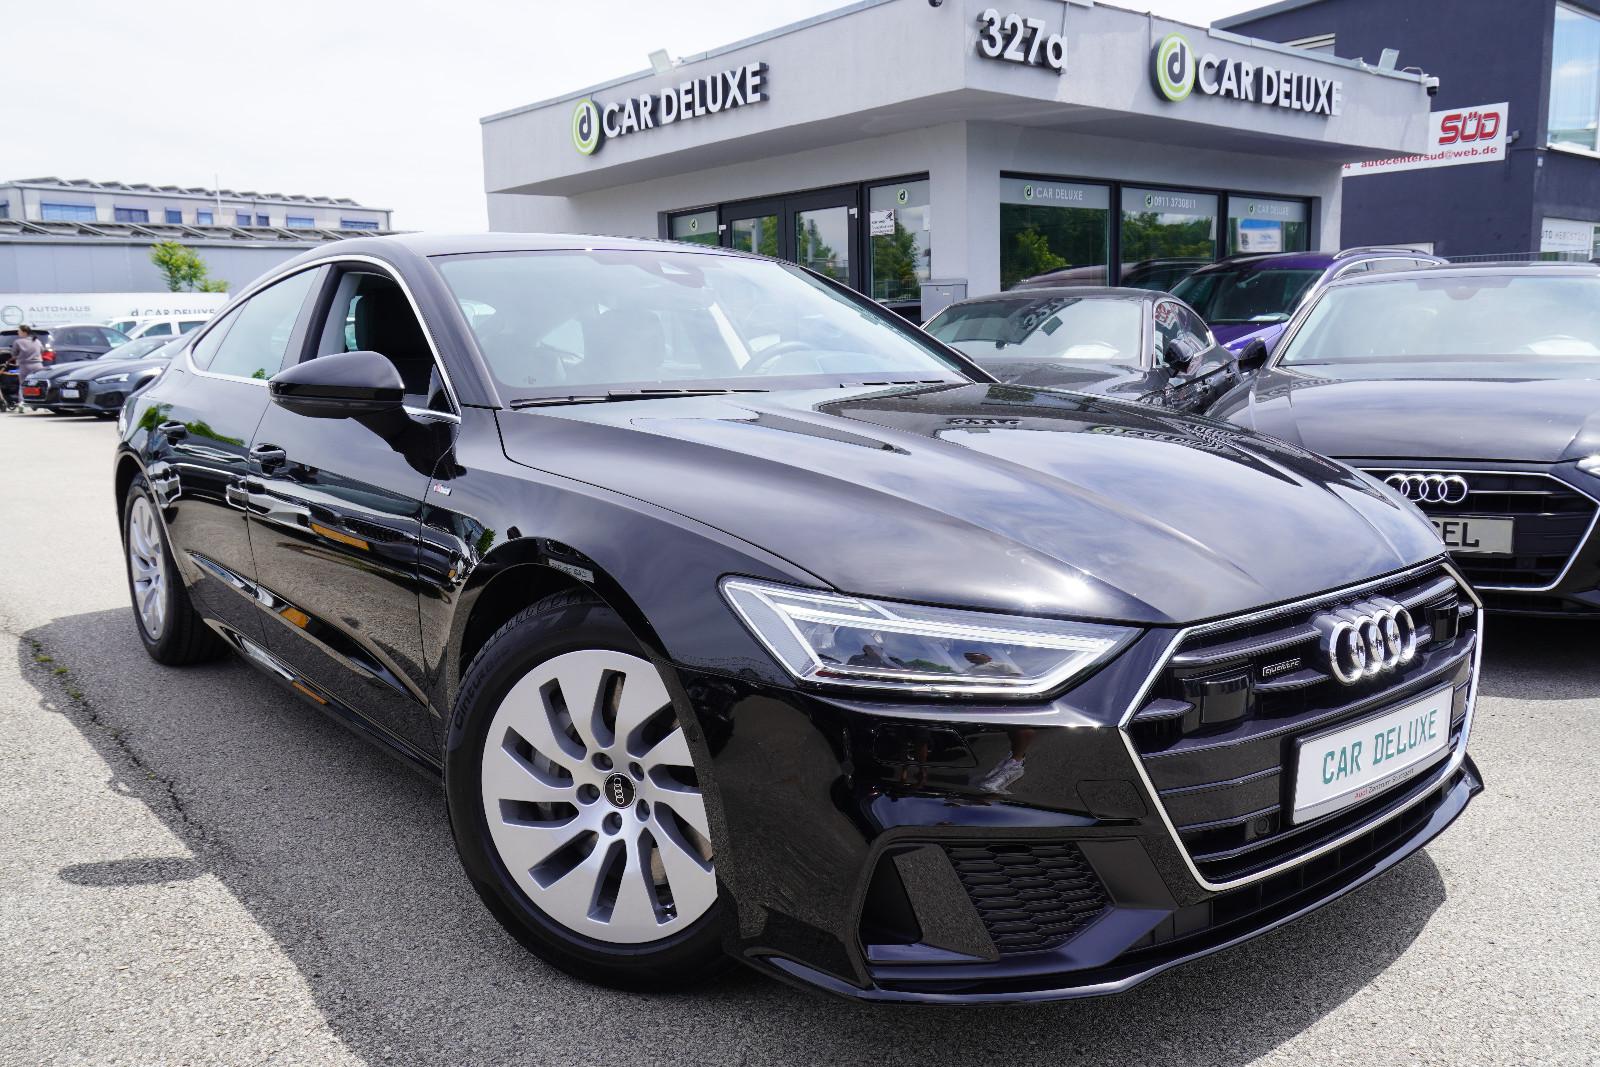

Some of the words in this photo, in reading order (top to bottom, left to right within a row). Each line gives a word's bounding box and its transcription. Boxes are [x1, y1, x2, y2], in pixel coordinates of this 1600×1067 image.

[982, 8, 1068, 69] 327a
[603, 93, 654, 138] CAR
[661, 60, 761, 125] DELUXE
[1198, 53, 1254, 101] CAR
[1262, 66, 1342, 116] DELUXE
[1438, 111, 1500, 146] SÜD
[1036, 187, 1053, 199] CAR
[1055, 188, 1083, 201] DELUXE
[29, 305, 91, 313] AUTOHAUS
[1432, 521, 1480, 547] EL
[1322, 741, 1362, 785] CAR
[1373, 709, 1438, 766] DELUXE
